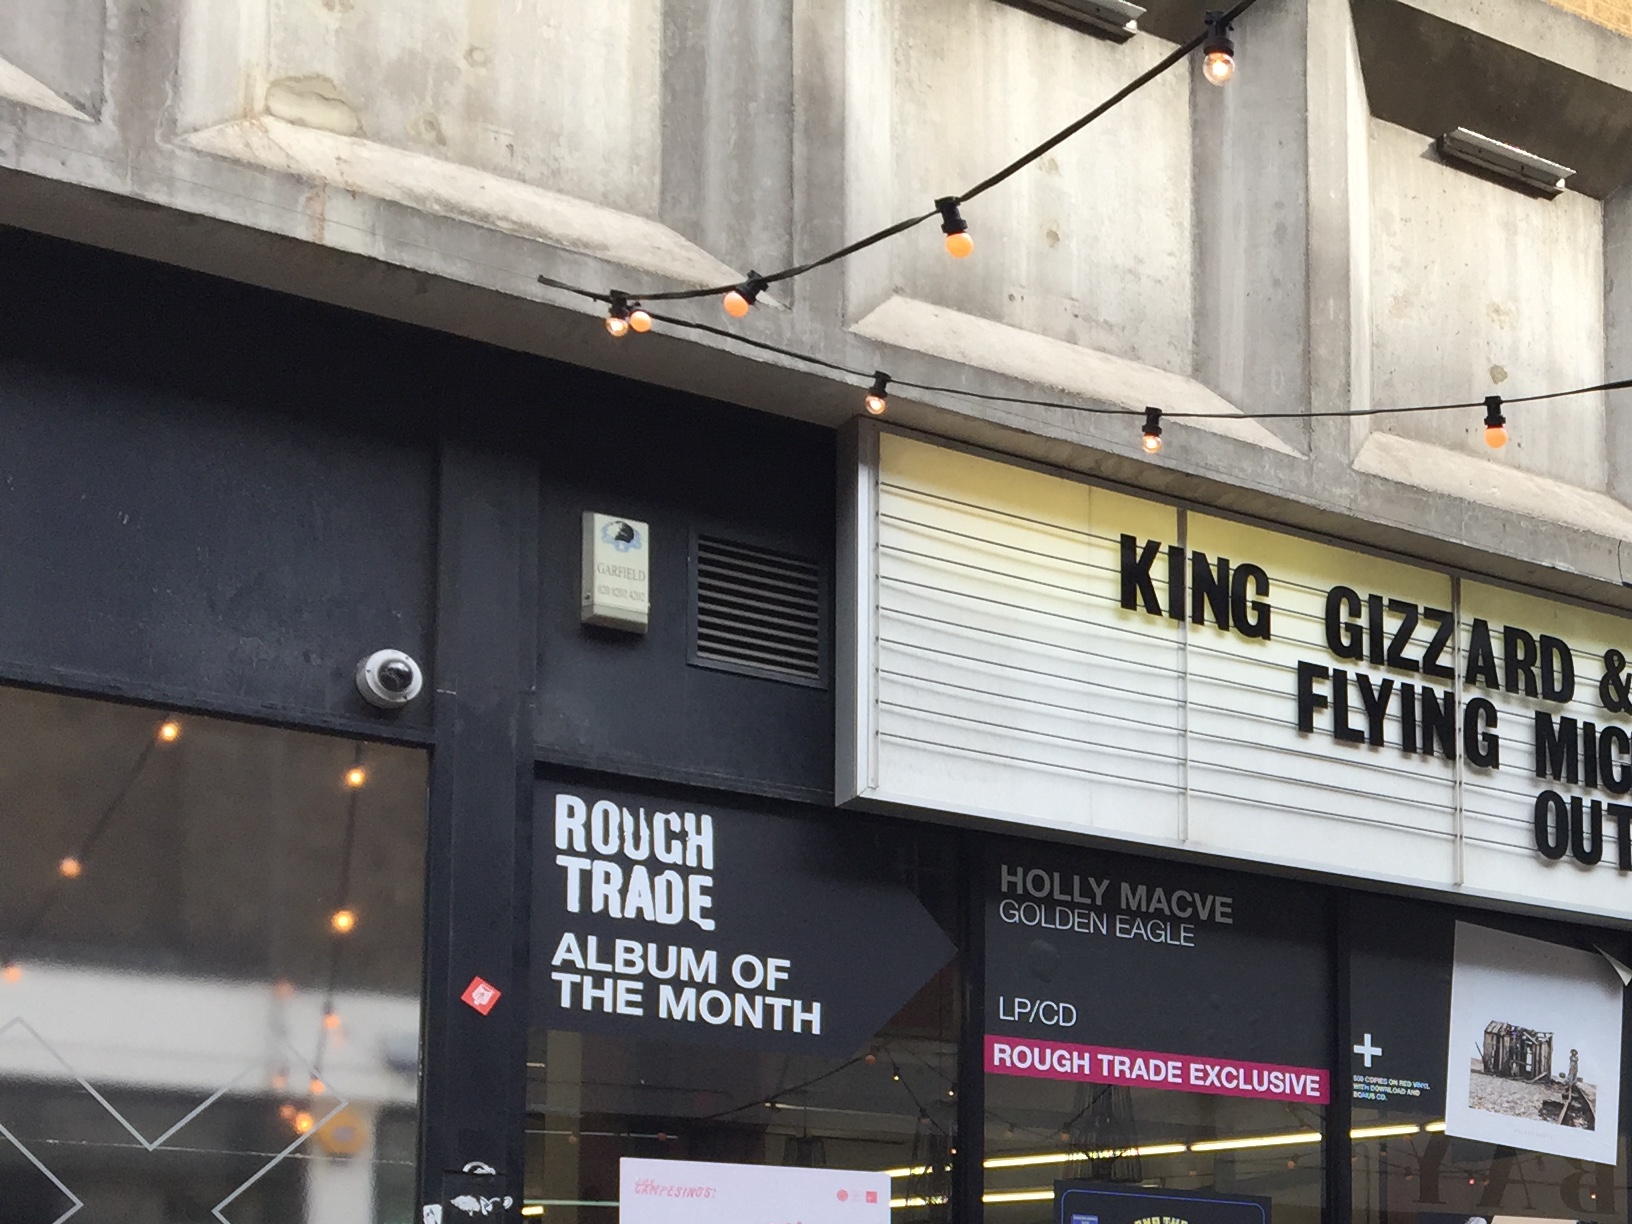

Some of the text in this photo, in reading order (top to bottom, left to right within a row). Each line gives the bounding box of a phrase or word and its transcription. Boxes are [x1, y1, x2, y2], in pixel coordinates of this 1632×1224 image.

[597, 562, 646, 581] GARFIELD
[1119, 533, 1272, 641] KING
[1325, 585, 1575, 704] GIZZARD
[1297, 660, 1500, 770] FLYING
[555, 793, 714, 870] ROUGH
[555, 854, 716, 931] TRADE
[999, 899, 1196, 948] GOLDEN EAGLE
[1000, 863, 1234, 925] HOLLY MACVE
[551, 931, 791, 992] ALBUM OF
[551, 971, 822, 1035] THE MONTH
[999, 995, 1078, 1027] LP/CD
[993, 1042, 1321, 1097] ROUGH TRADE EXCLUSIVE
